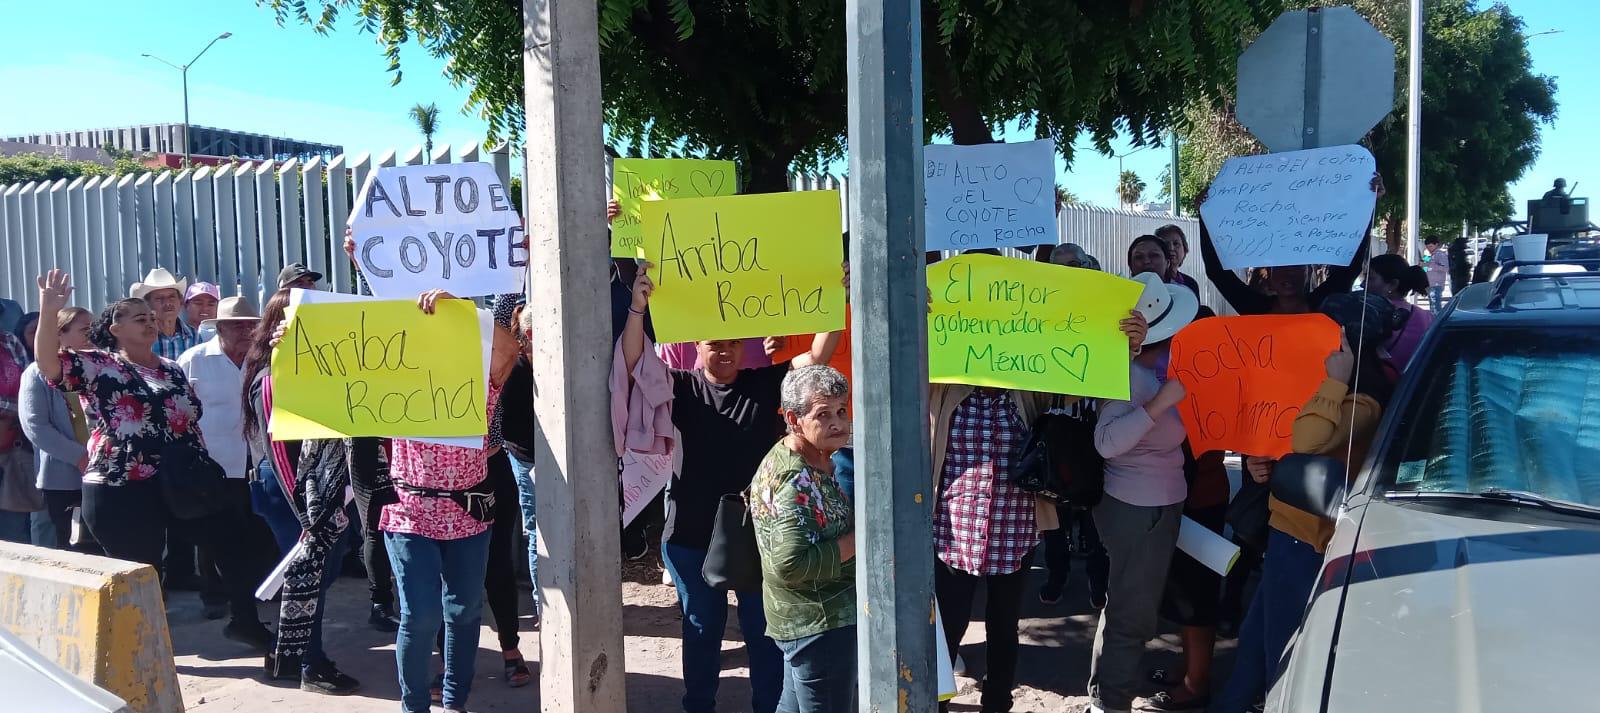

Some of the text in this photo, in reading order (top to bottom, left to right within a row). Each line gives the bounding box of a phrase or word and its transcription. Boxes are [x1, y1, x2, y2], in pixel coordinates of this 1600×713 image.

[365, 175, 517, 217] ALTO E
[954, 160, 1008, 186] ALTO
[945, 206, 1018, 228] COYOTE
[993, 225, 1046, 243] Rocha
[361, 226, 529, 280] COYOTE
[659, 212, 769, 286] Arriba
[716, 274, 829, 322] Rocha
[945, 262, 1061, 316] El mejor
[294, 310, 419, 377] Arriba
[934, 310, 1087, 346] gobernador de
[964, 343, 1047, 374] México
[1171, 324, 1277, 384] Rocha
[345, 369, 482, 424] Rocha
